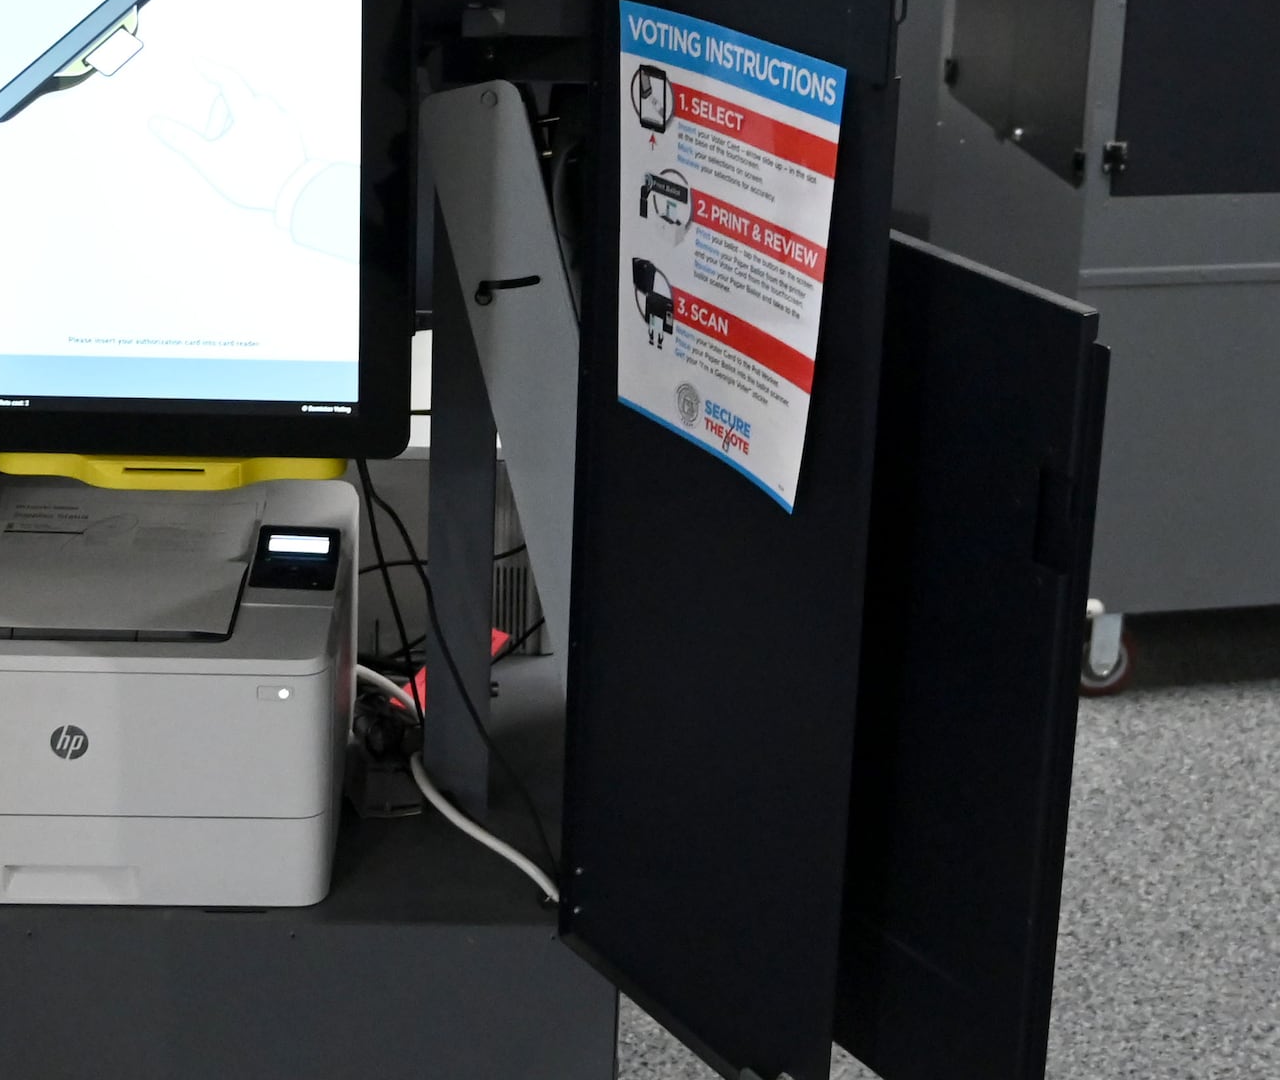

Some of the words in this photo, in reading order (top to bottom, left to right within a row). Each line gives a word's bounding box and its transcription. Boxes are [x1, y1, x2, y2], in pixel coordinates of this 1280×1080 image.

[628, 14, 701, 58] VOTING
[705, 35, 837, 106] INSTRUCTIONS
[679, 93, 689, 111] 1.
[692, 98, 744, 131] SELECT
[697, 200, 708, 218] 2.
[711, 205, 750, 236] PRINT
[752, 224, 762, 242] &
[764, 229, 818, 269] REVIEW
[678, 297, 688, 317] 3.
[690, 304, 729, 336] SCAN
[704, 400, 752, 439] SECURE
[54, 724, 85, 760] hp
